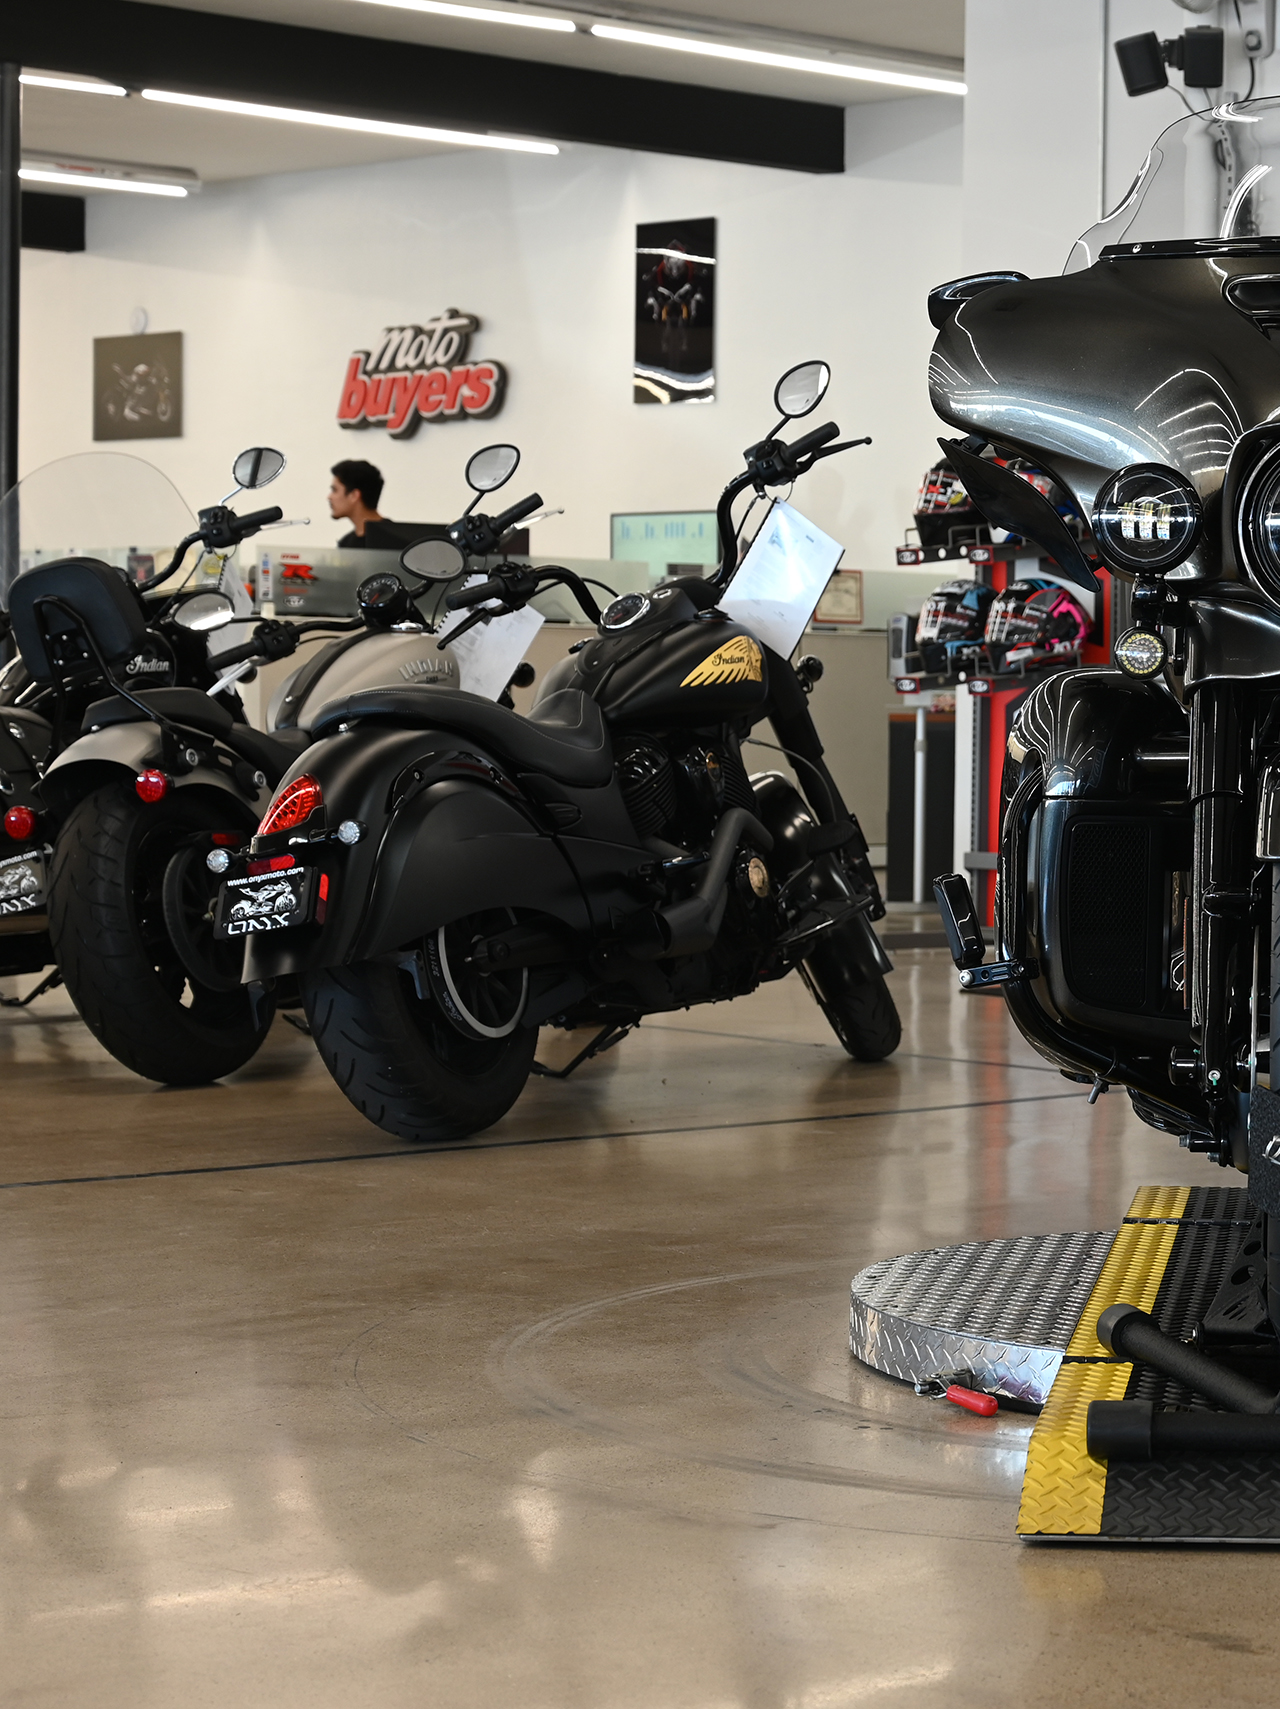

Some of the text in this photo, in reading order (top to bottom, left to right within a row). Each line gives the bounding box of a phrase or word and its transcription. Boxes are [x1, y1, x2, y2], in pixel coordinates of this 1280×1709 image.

[336, 354, 495, 432] buyers
[126, 654, 169, 675] Indian
[399, 658, 454, 680] INDIAN
[712, 653, 745, 667] Indian
[227, 866, 305, 887] www.onyxmoto.com
